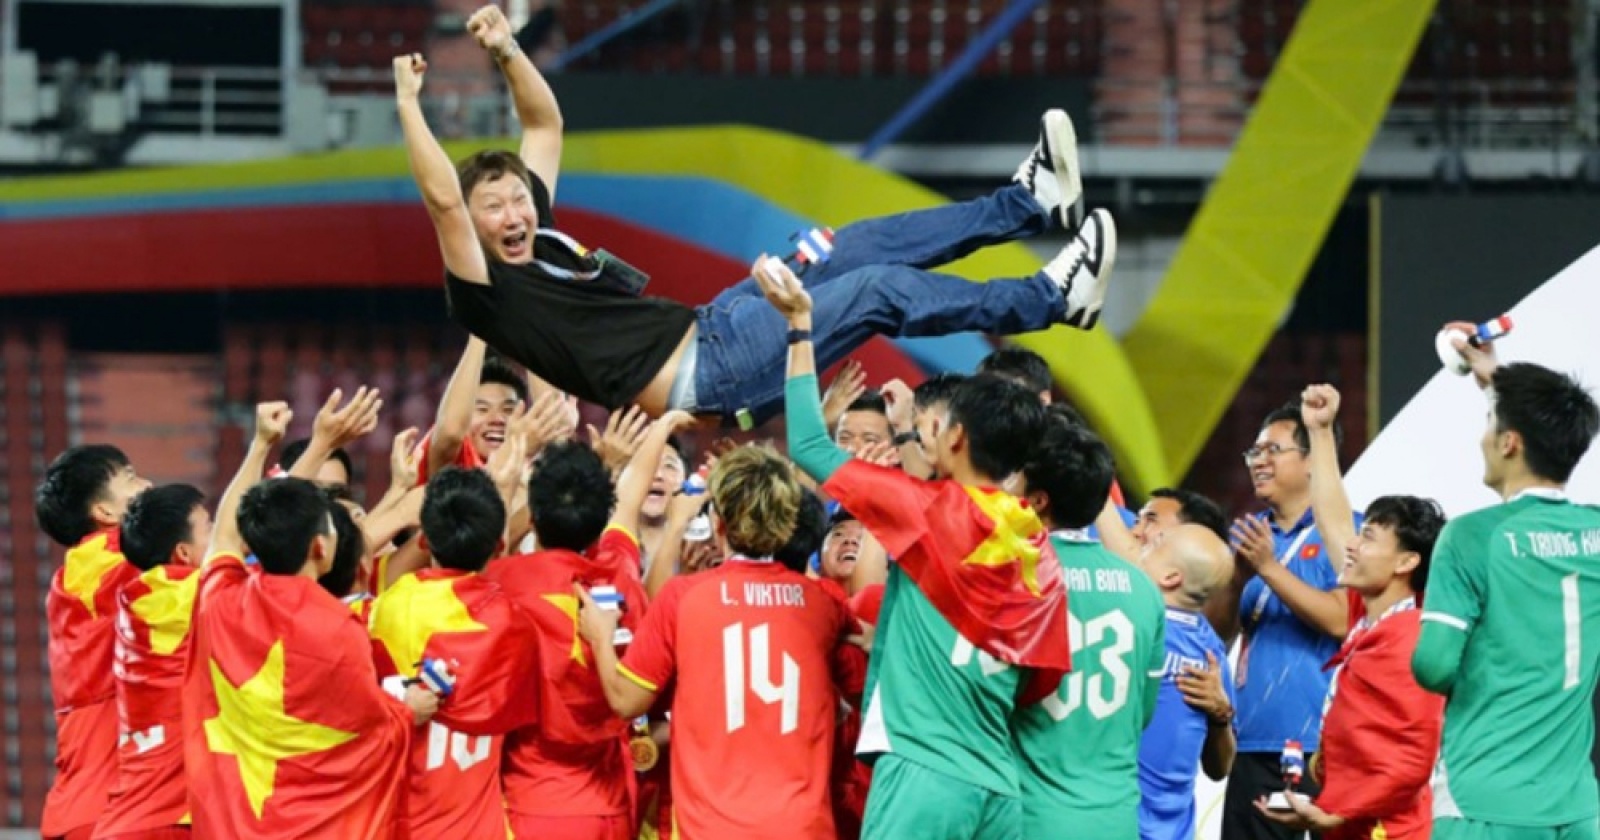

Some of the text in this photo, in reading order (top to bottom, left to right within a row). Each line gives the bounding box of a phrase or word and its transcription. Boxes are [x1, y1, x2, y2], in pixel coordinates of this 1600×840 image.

[1503, 532, 1526, 557] T.
[1526, 532, 1578, 557] TRUNG
[721, 580, 806, 606] L. VIKTOR
[1096, 568, 1131, 592] BINH
[1561, 571, 1580, 690] 1
[723, 622, 799, 735] 14
